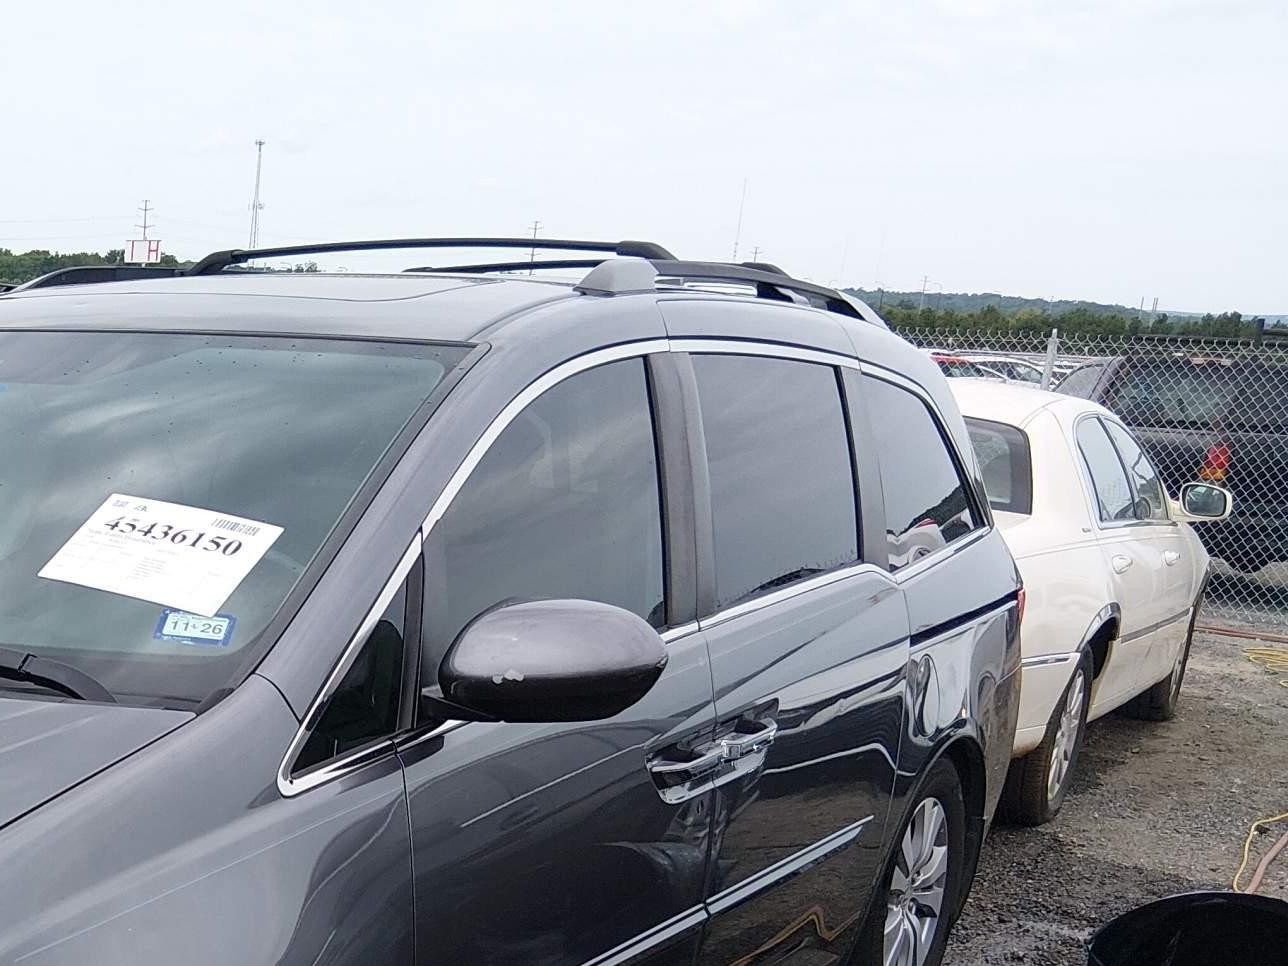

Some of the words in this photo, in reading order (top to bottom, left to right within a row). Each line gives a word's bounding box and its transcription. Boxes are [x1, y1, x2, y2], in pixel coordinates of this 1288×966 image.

[104, 516, 243, 557] 45436150
[171, 620, 190, 632] 11
[200, 623, 224, 635] 26
